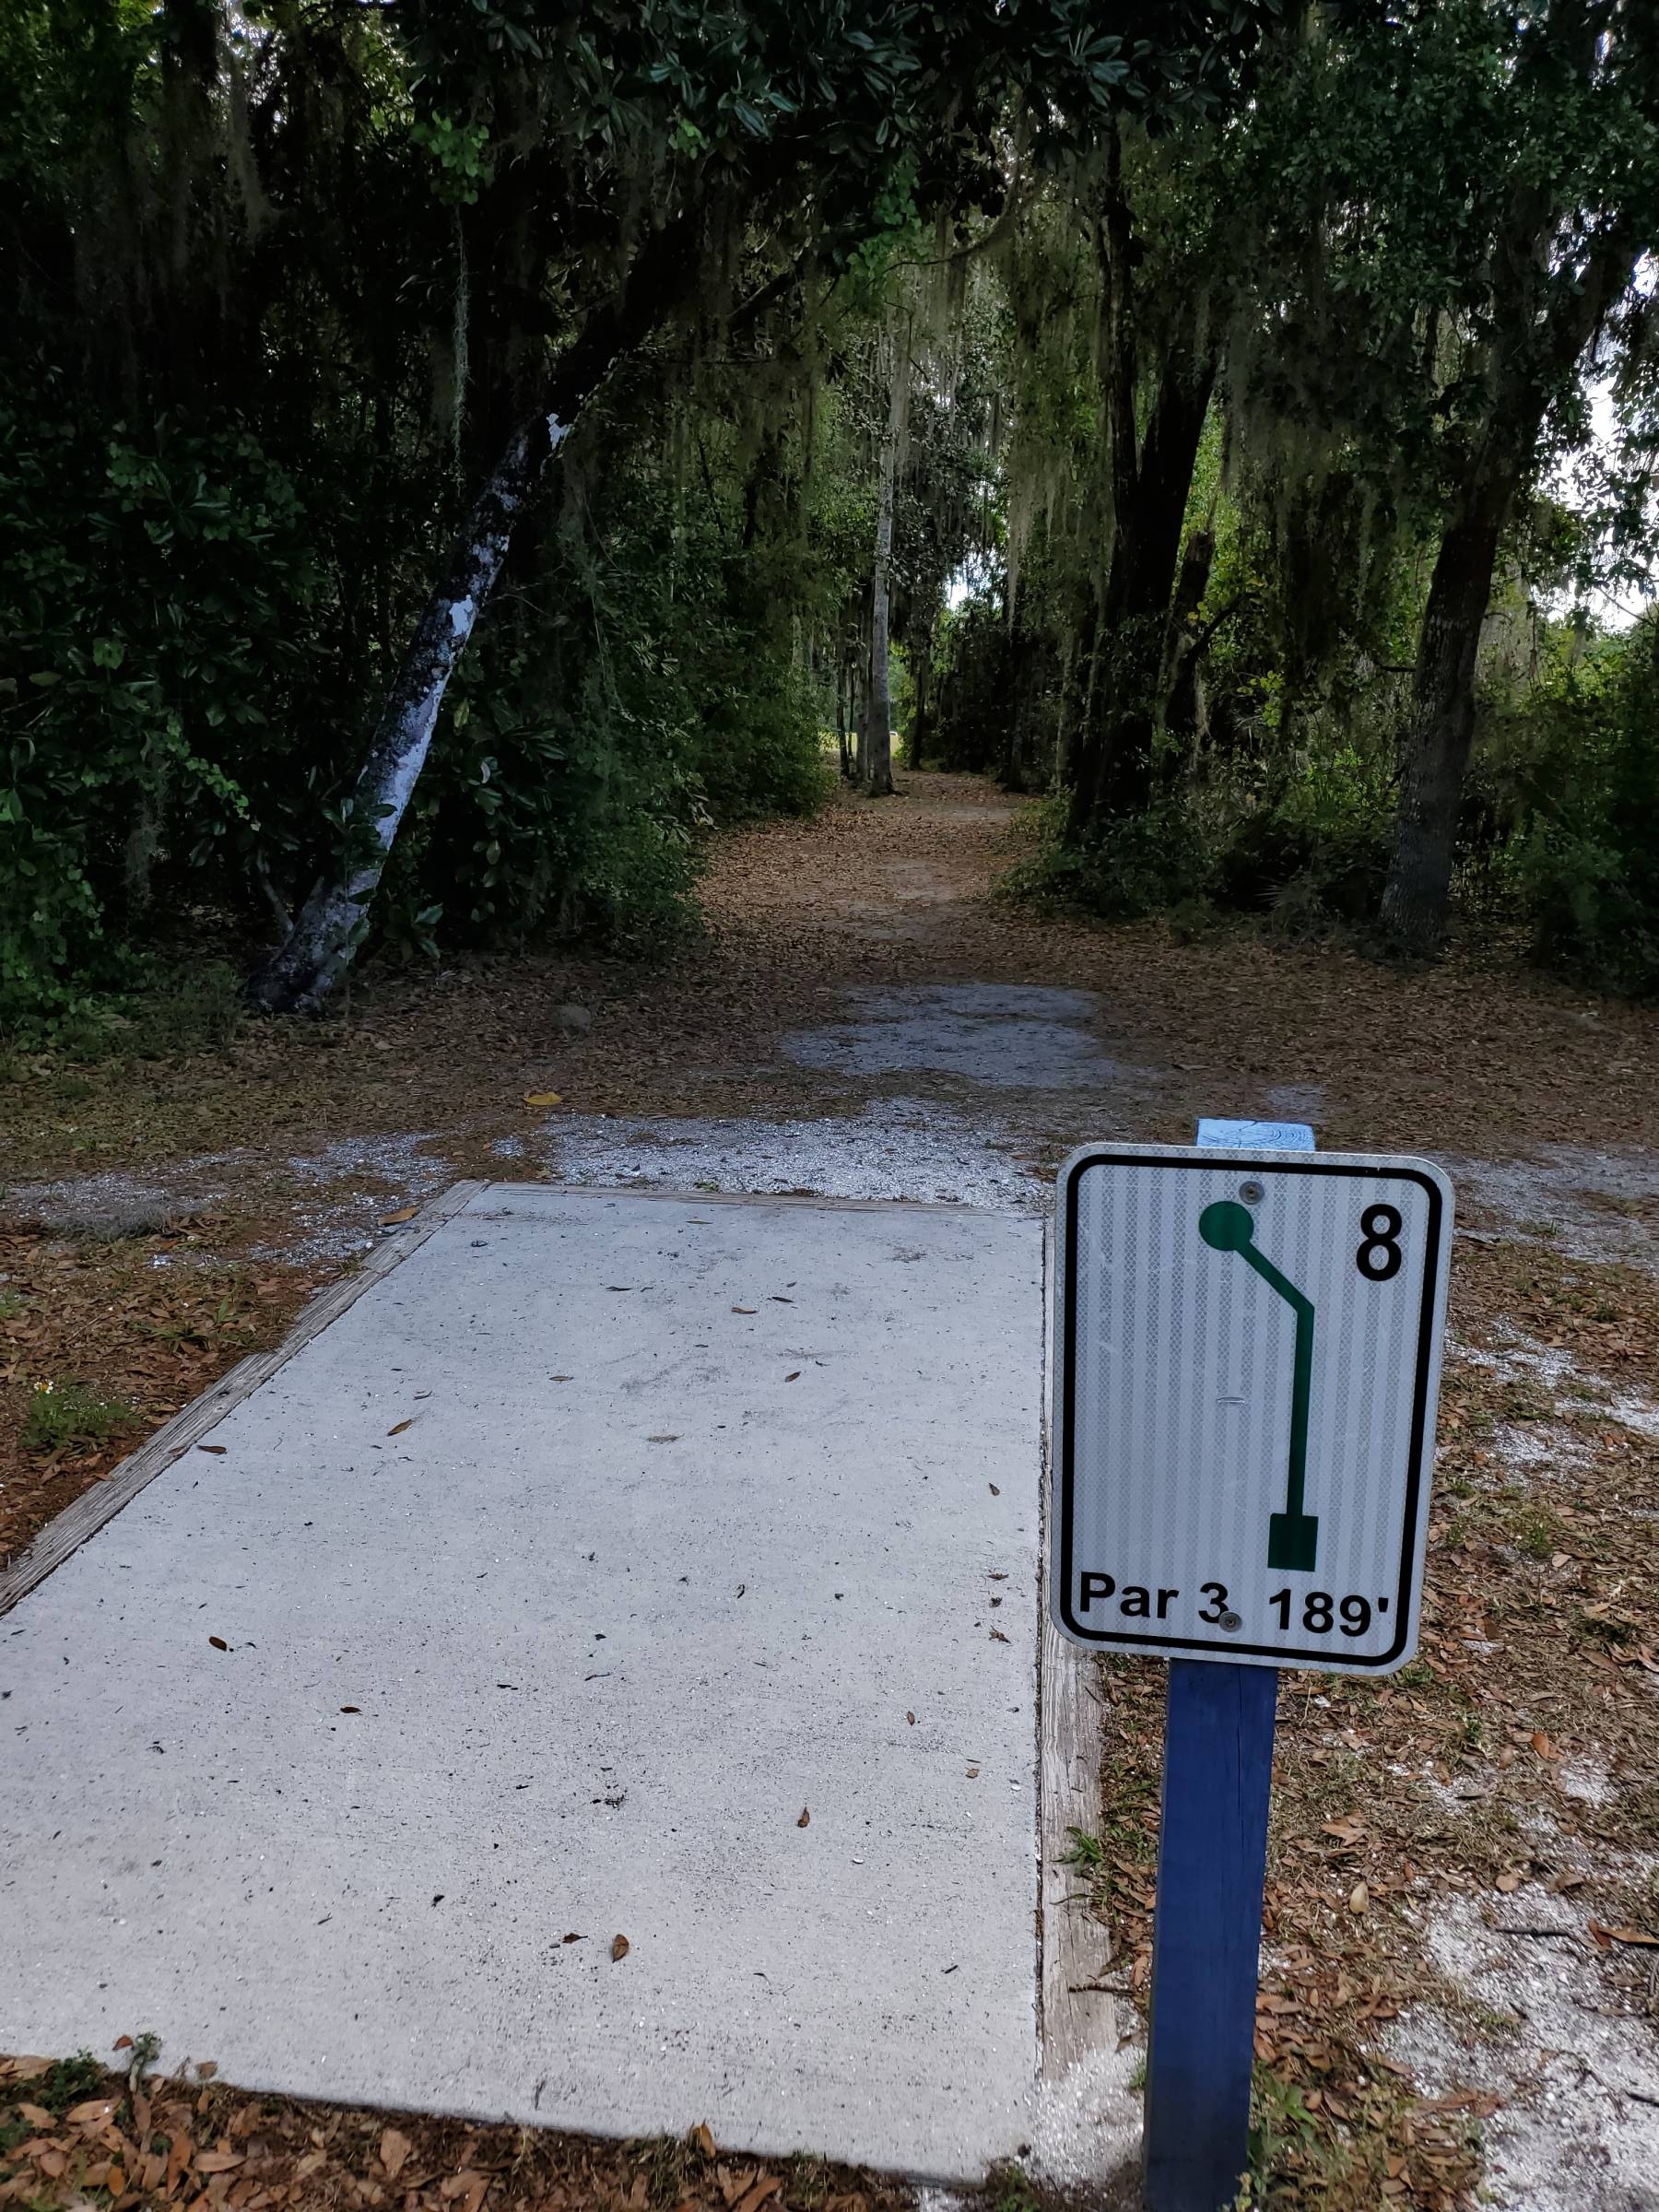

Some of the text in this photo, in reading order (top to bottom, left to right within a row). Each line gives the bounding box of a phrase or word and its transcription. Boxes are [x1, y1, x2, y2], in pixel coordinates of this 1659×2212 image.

[1355, 1203, 1403, 1282] 8
[1079, 1571, 1389, 1638] Par 3 189'
